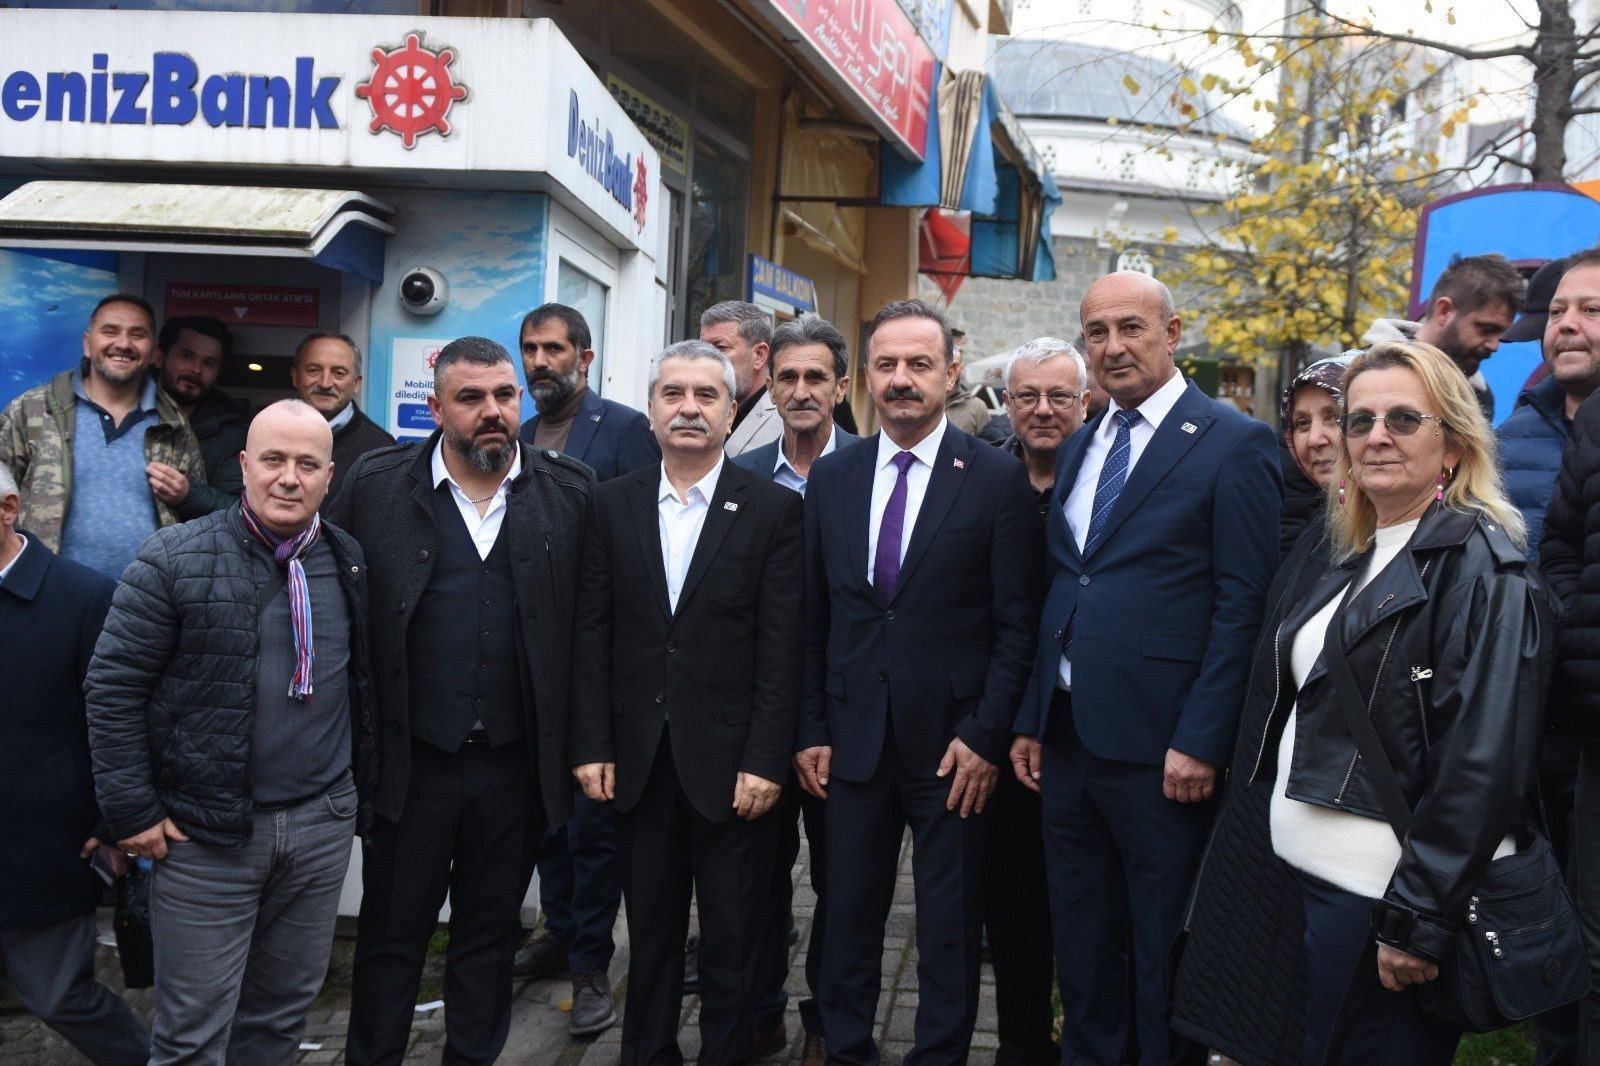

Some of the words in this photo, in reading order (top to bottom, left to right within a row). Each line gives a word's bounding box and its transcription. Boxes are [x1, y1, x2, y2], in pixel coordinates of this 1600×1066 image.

[567, 87, 633, 213] DenizBank
[170, 289, 191, 298] TÜM
[192, 290, 246, 301] KARTLARIN
[248, 292, 280, 302] ORTAK
